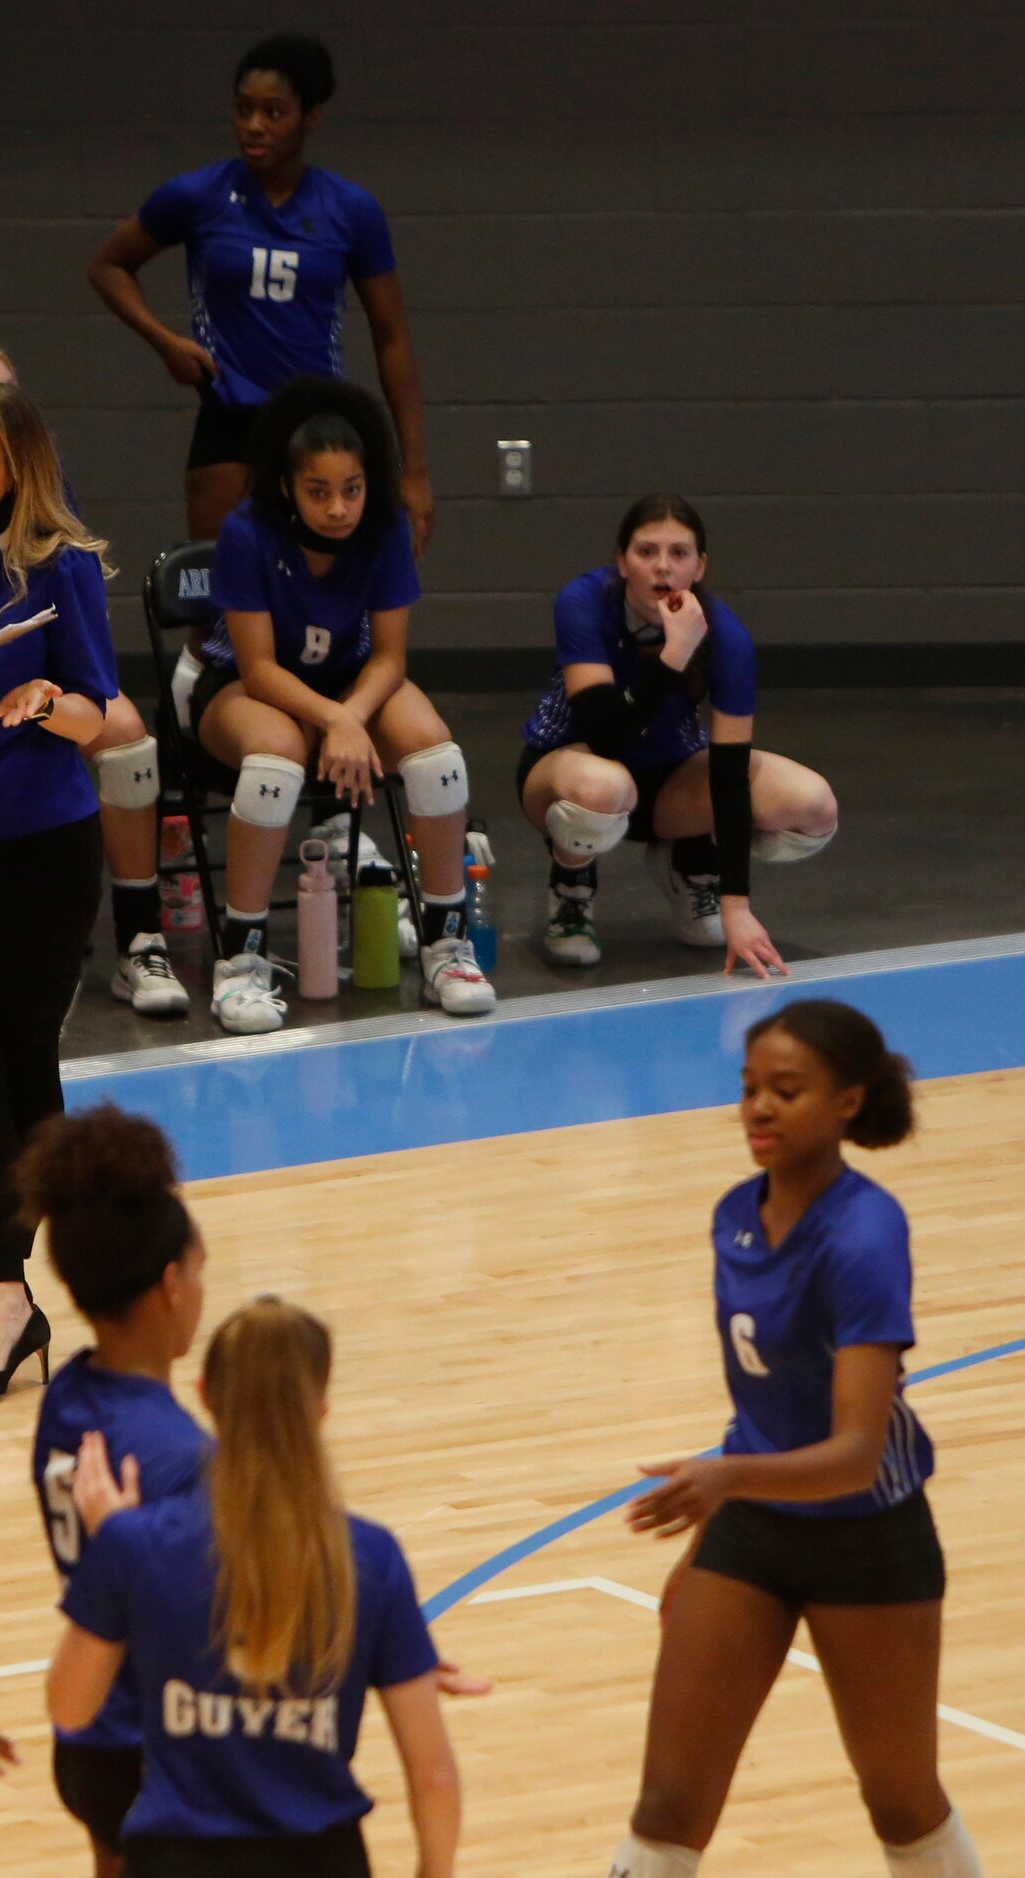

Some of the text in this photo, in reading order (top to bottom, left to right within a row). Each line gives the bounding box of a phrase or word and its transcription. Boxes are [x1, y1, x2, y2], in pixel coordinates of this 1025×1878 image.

[249, 246, 300, 303] 15
[300, 624, 331, 665] 8
[729, 1312, 771, 1377] 6
[44, 1447, 81, 1566] 5
[162, 1677, 340, 1756] GUYER
